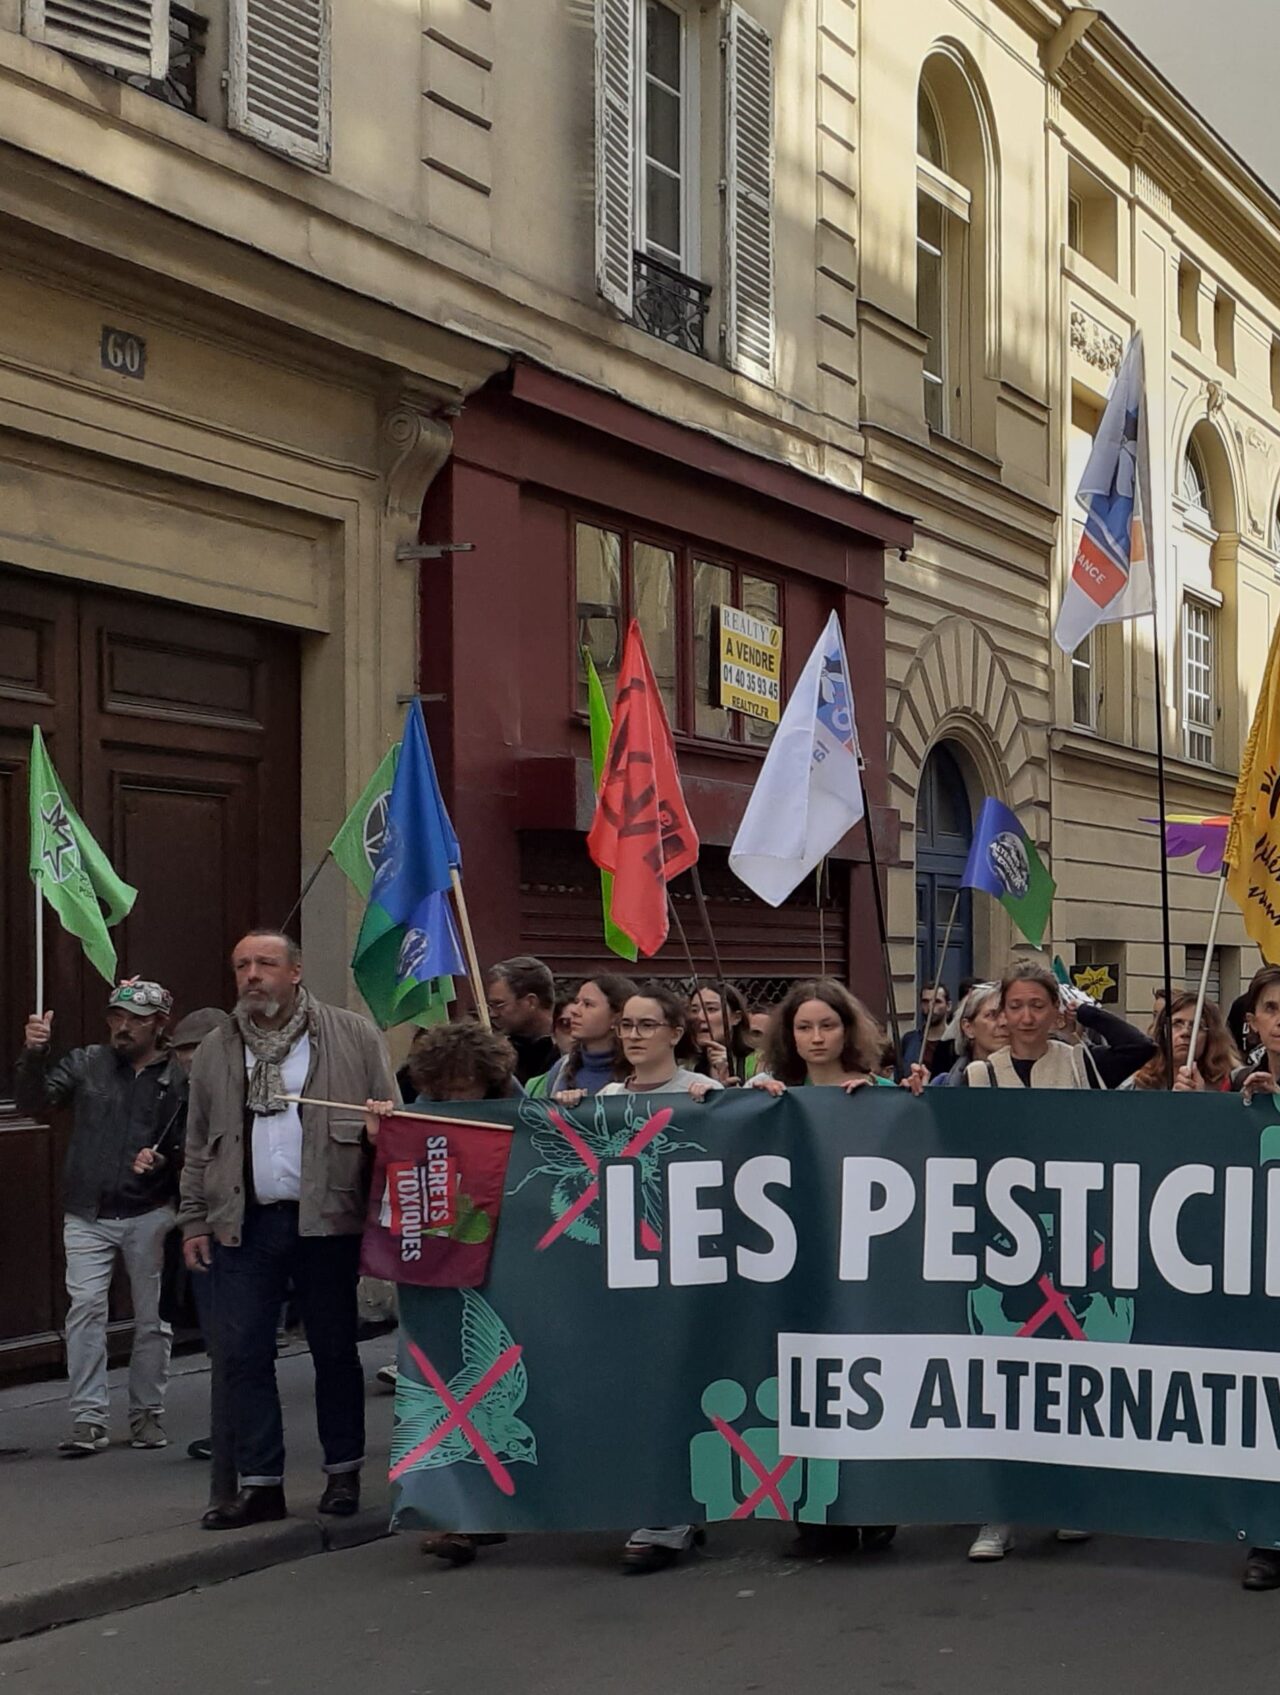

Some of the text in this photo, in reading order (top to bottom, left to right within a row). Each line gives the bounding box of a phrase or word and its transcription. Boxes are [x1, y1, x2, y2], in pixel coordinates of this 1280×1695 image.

[107, 333, 140, 372] 60
[723, 664, 778, 700] 01 40 35 93 45
[726, 638, 775, 673] A VENDRE
[397, 1166, 422, 1263] TOXIQUES
[426, 1136, 449, 1222] SECRETS
[606, 1155, 798, 1289] LES
[790, 1357, 884, 1431] LES
